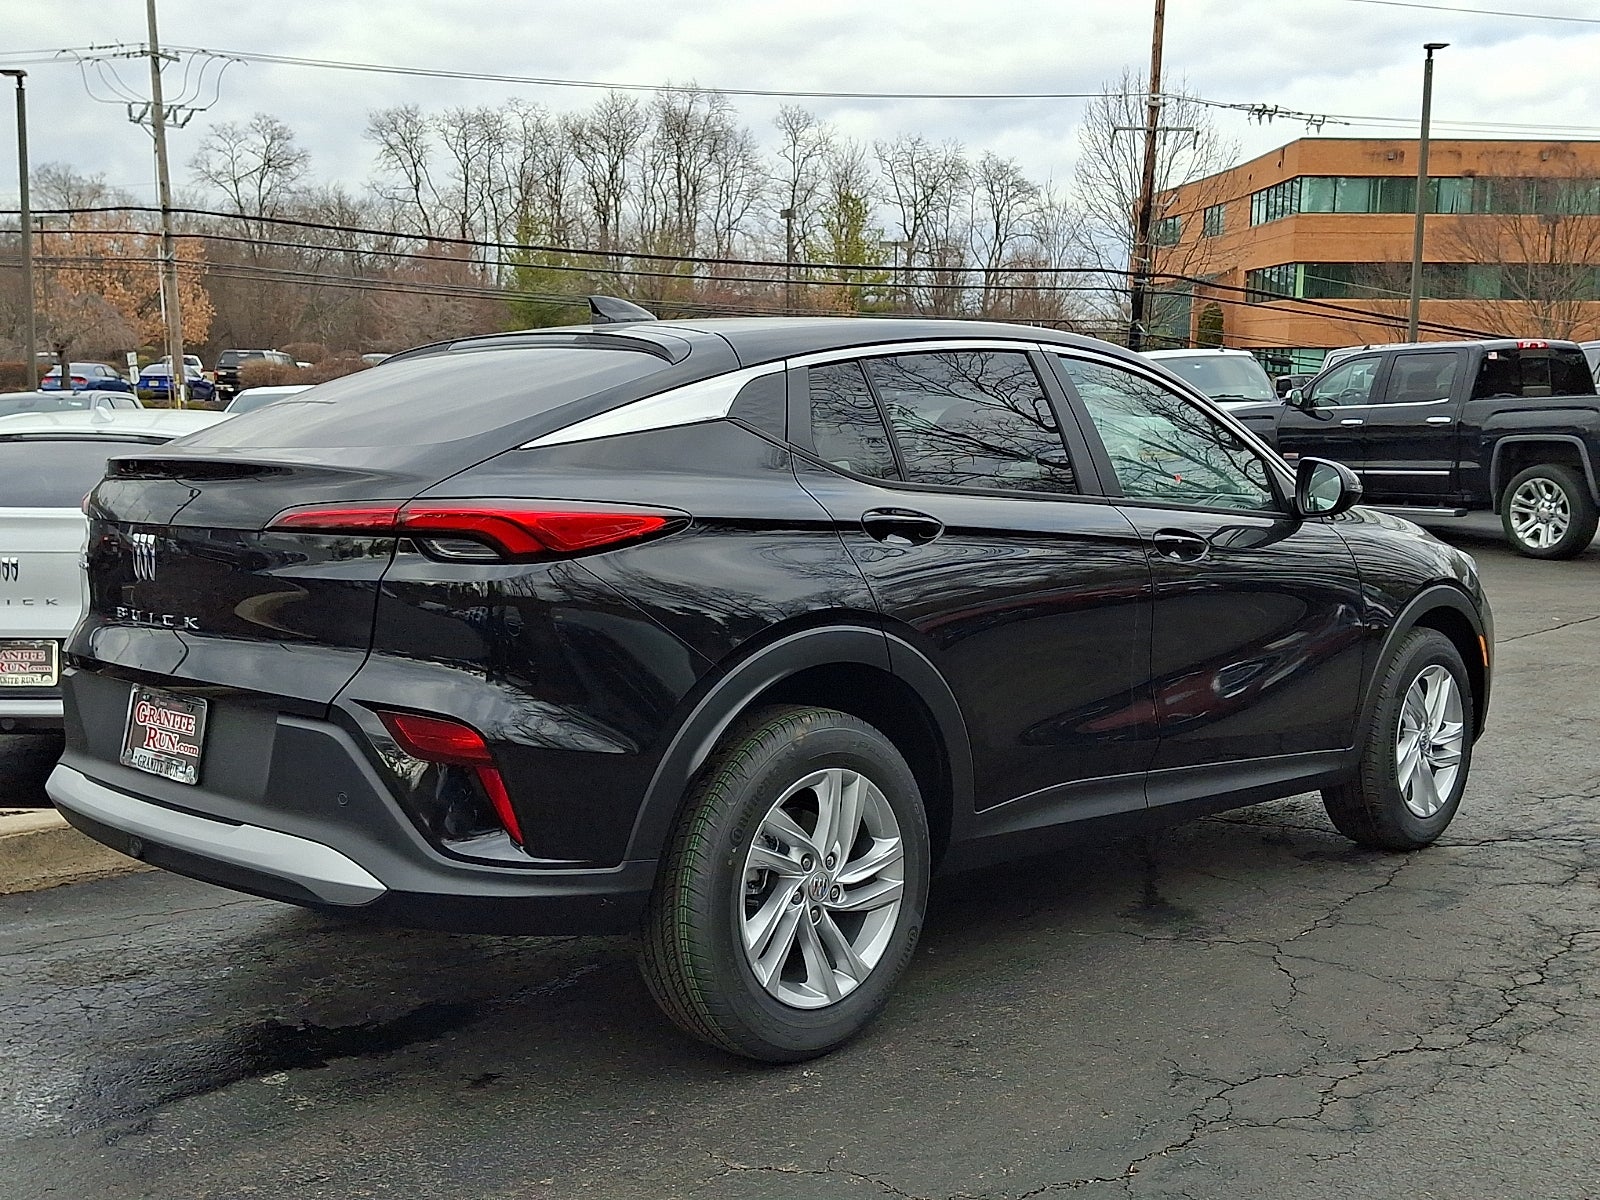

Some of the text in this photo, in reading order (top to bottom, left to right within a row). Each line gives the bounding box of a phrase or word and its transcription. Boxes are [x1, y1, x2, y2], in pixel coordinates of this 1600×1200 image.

[5, 598, 58, 606] ICK
[116, 606, 200, 630] BUICK
[0, 650, 45, 661] ANITE
[136, 701, 196, 735] GRANITE
[144, 726, 199, 756] RUN.com
[137, 754, 164, 774] GRANITE
